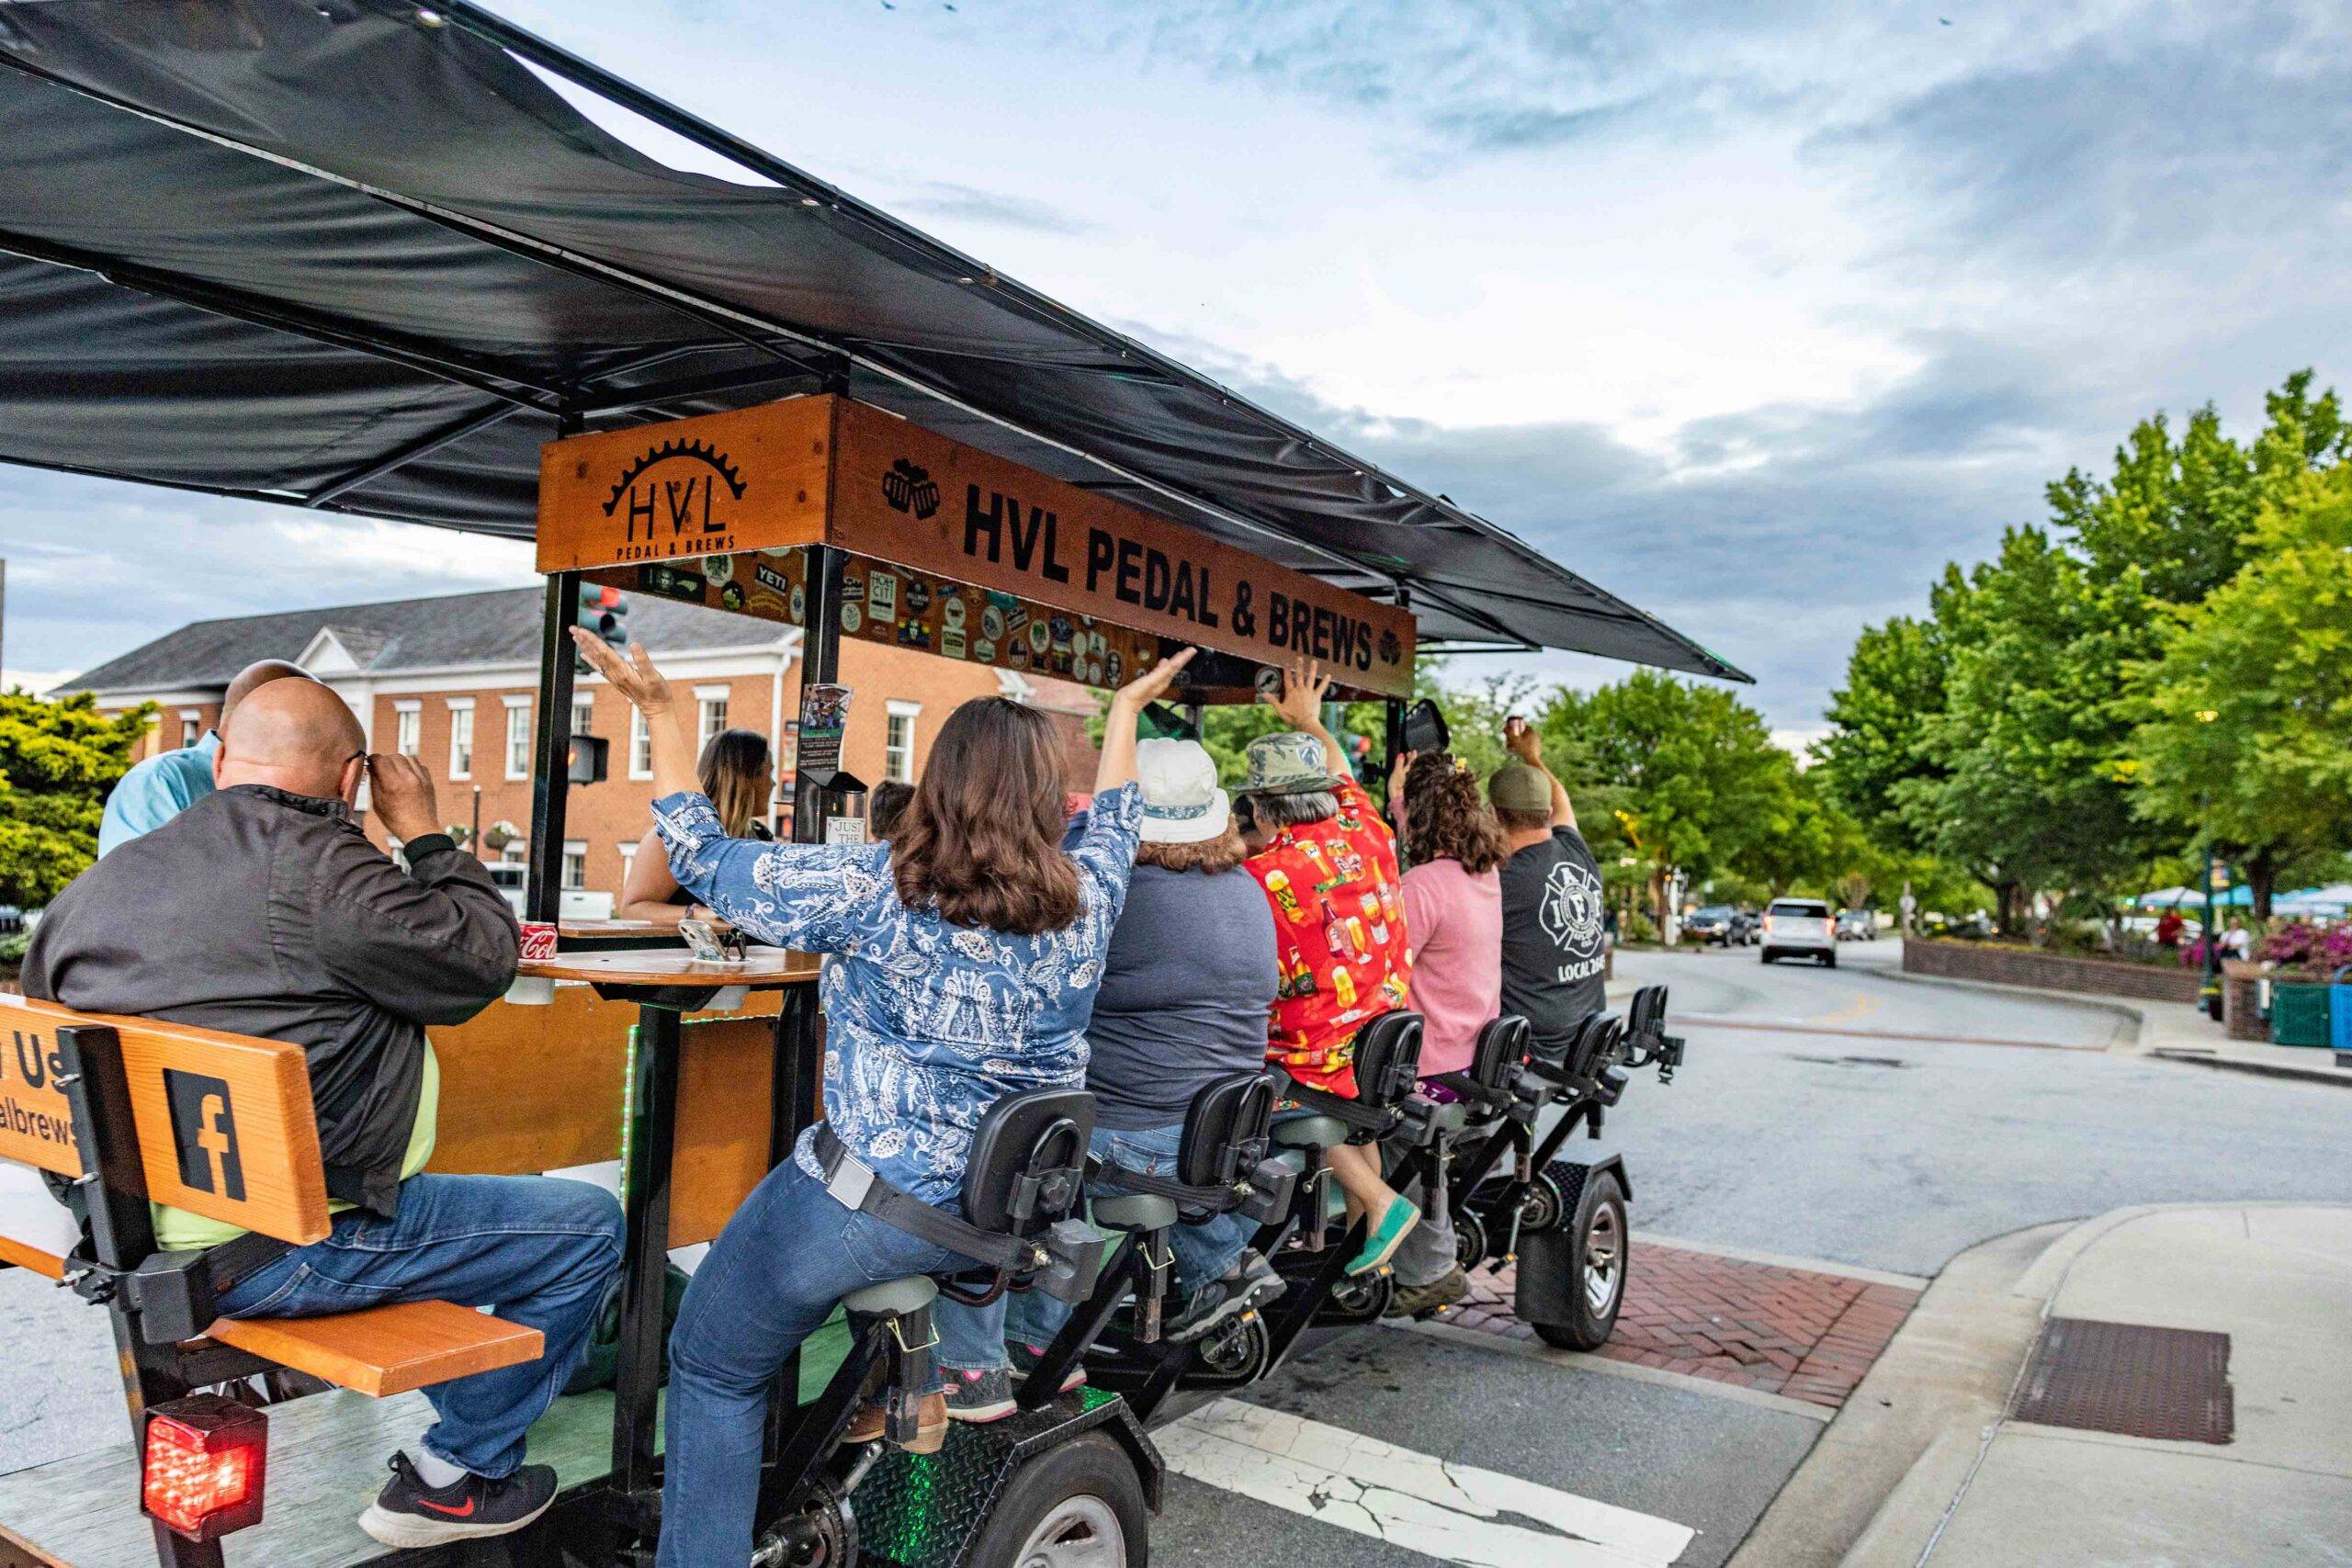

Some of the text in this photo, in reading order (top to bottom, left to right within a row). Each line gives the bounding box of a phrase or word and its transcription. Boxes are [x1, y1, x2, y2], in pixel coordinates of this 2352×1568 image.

[628, 475, 727, 542] HVL
[616, 535, 734, 560] PEDAL & BREWS
[758, 565, 787, 591] YETI
[965, 483, 1373, 672] HVL PEDAL & BREWS
[834, 821, 862, 832] JUST
[838, 833, 859, 844] THE
[1558, 960, 1590, 982] LOCAL
